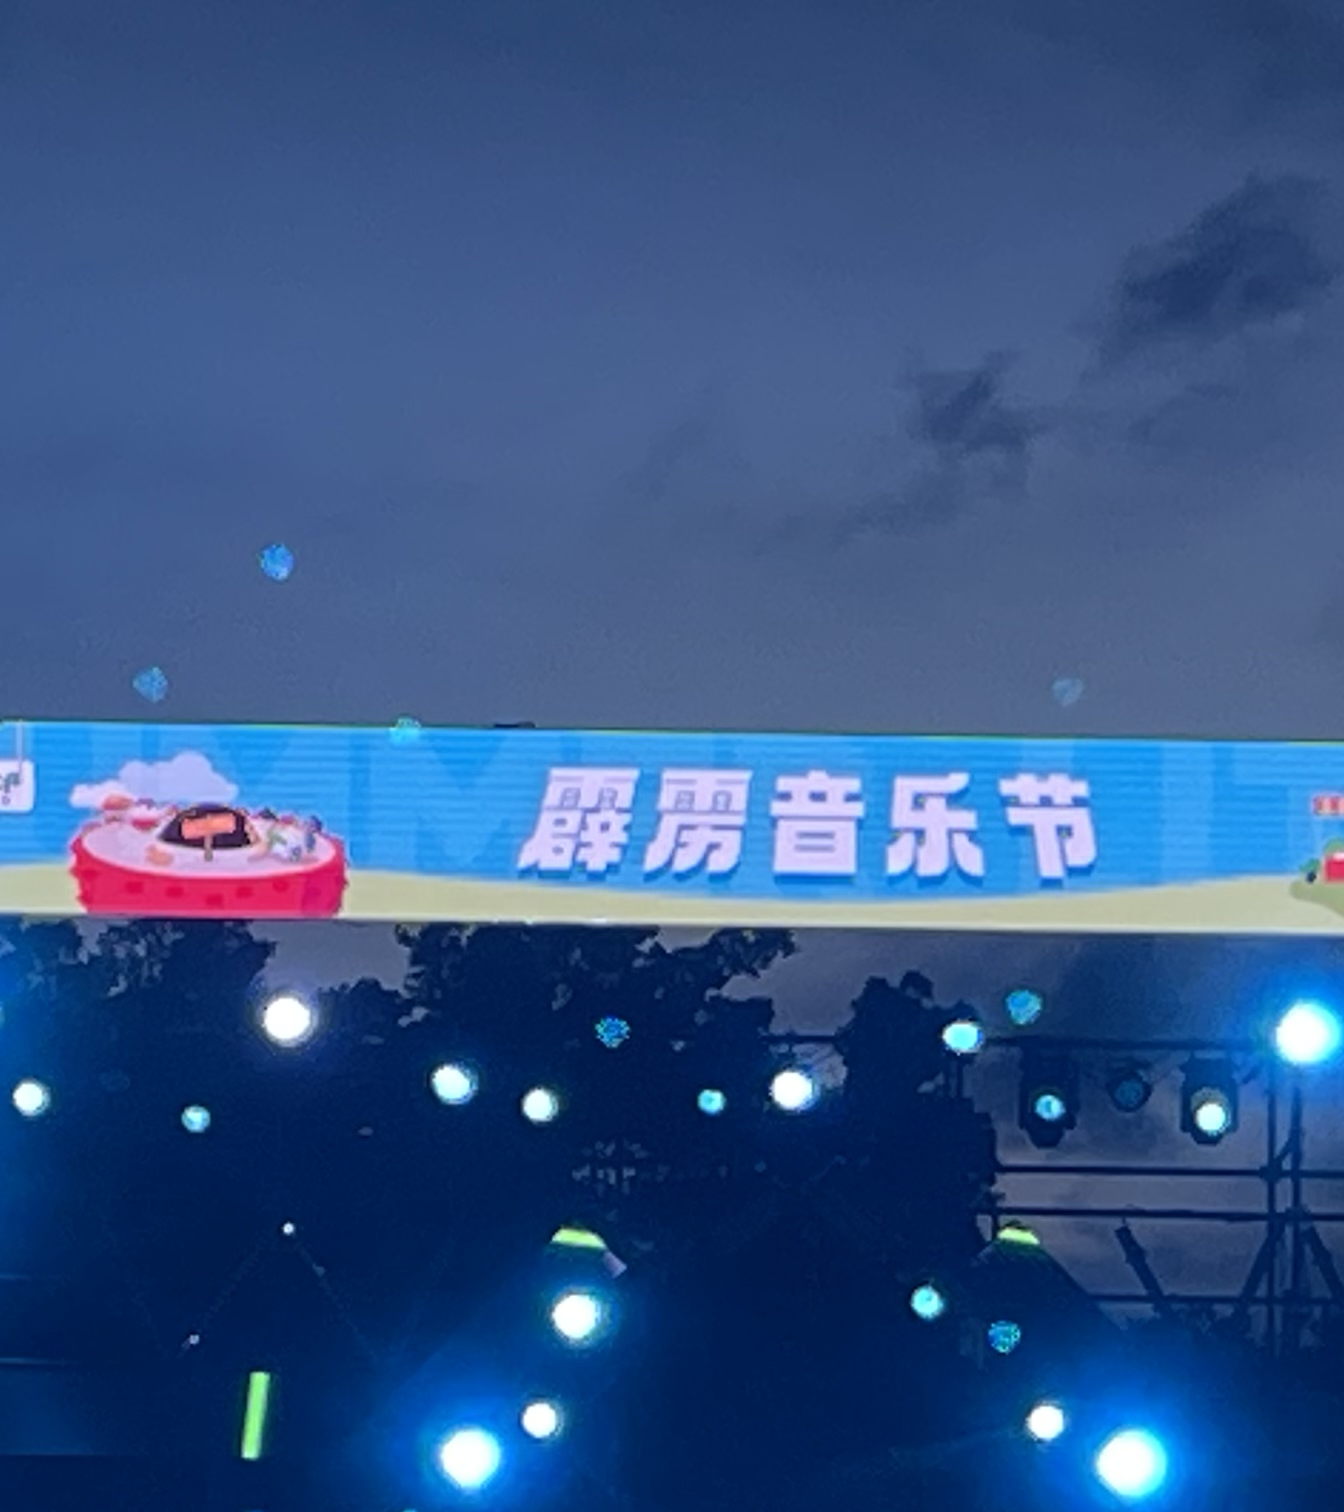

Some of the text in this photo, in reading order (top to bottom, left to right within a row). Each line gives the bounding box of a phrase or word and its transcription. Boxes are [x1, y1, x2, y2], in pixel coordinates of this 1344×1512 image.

[517, 767, 1097, 880] 霹雳音乐节
